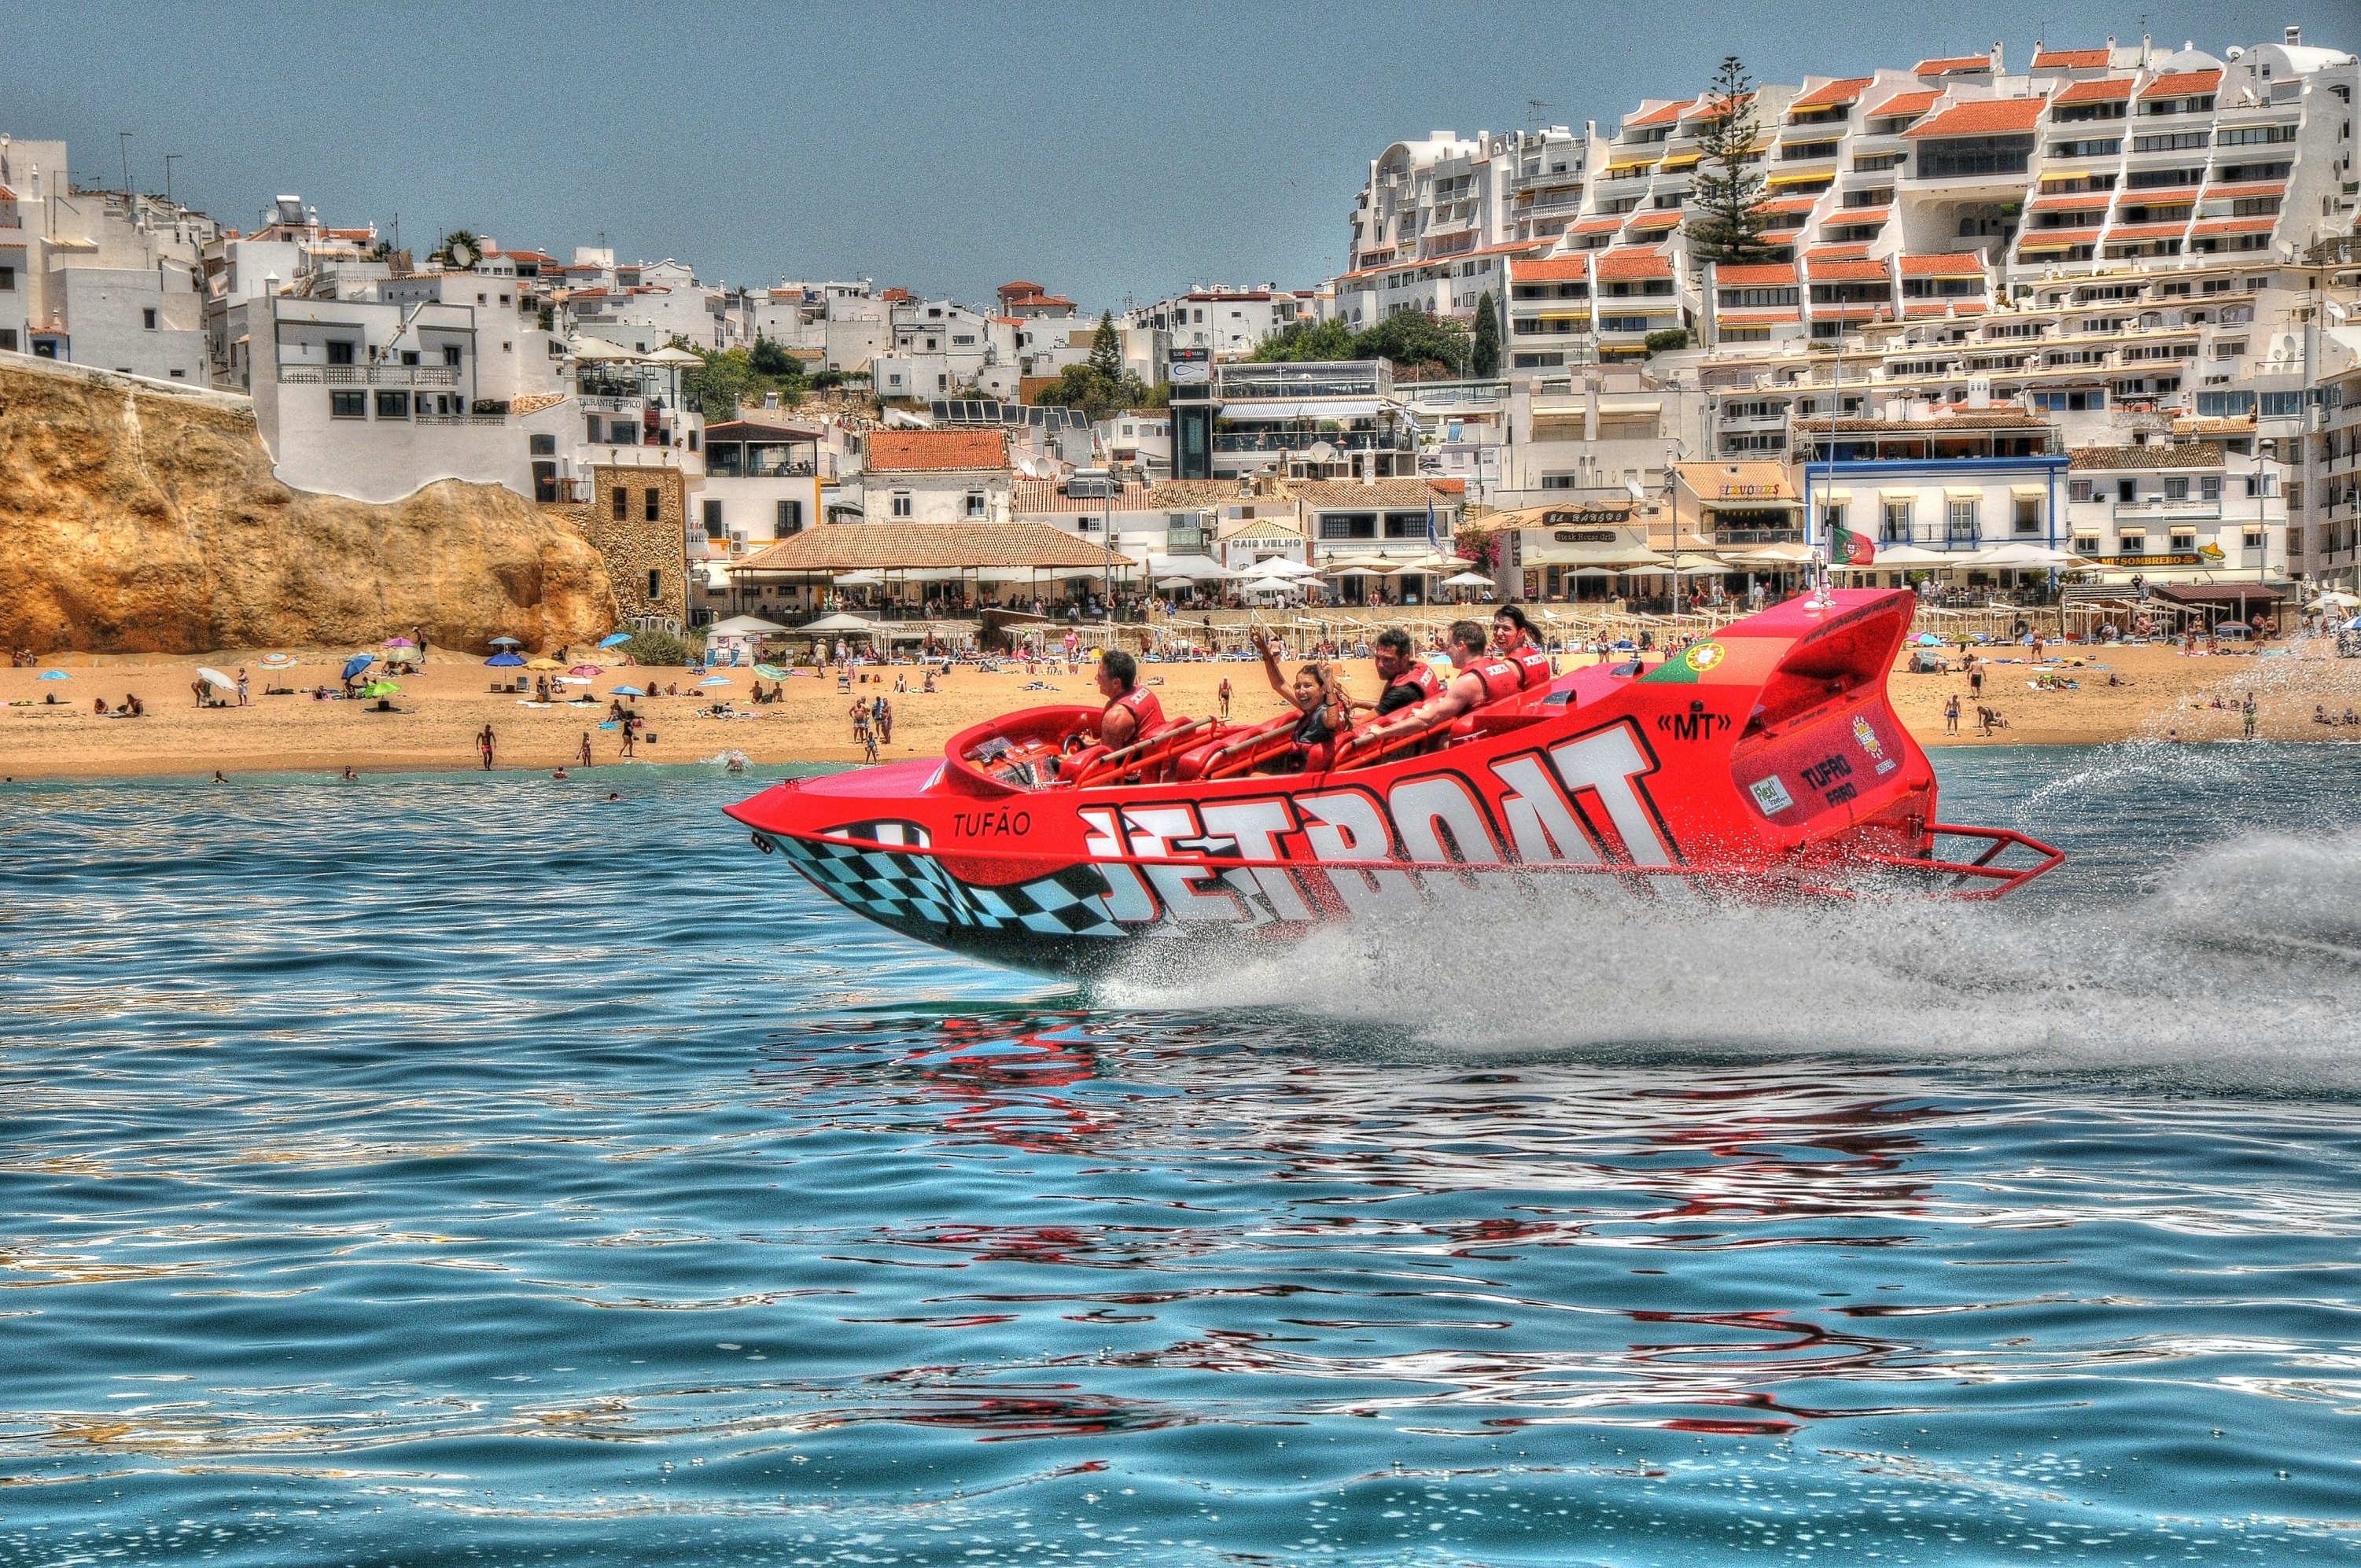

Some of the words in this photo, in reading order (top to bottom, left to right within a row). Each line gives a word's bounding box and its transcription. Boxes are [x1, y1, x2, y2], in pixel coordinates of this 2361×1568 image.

[1573, 513, 1622, 522] RANCHO
[1262, 539, 1302, 548] VELHO
[2120, 556, 2182, 565] SOMBRERO
[953, 805, 1031, 837] TUFÃO
[1077, 714, 1683, 922] JETBOAT
